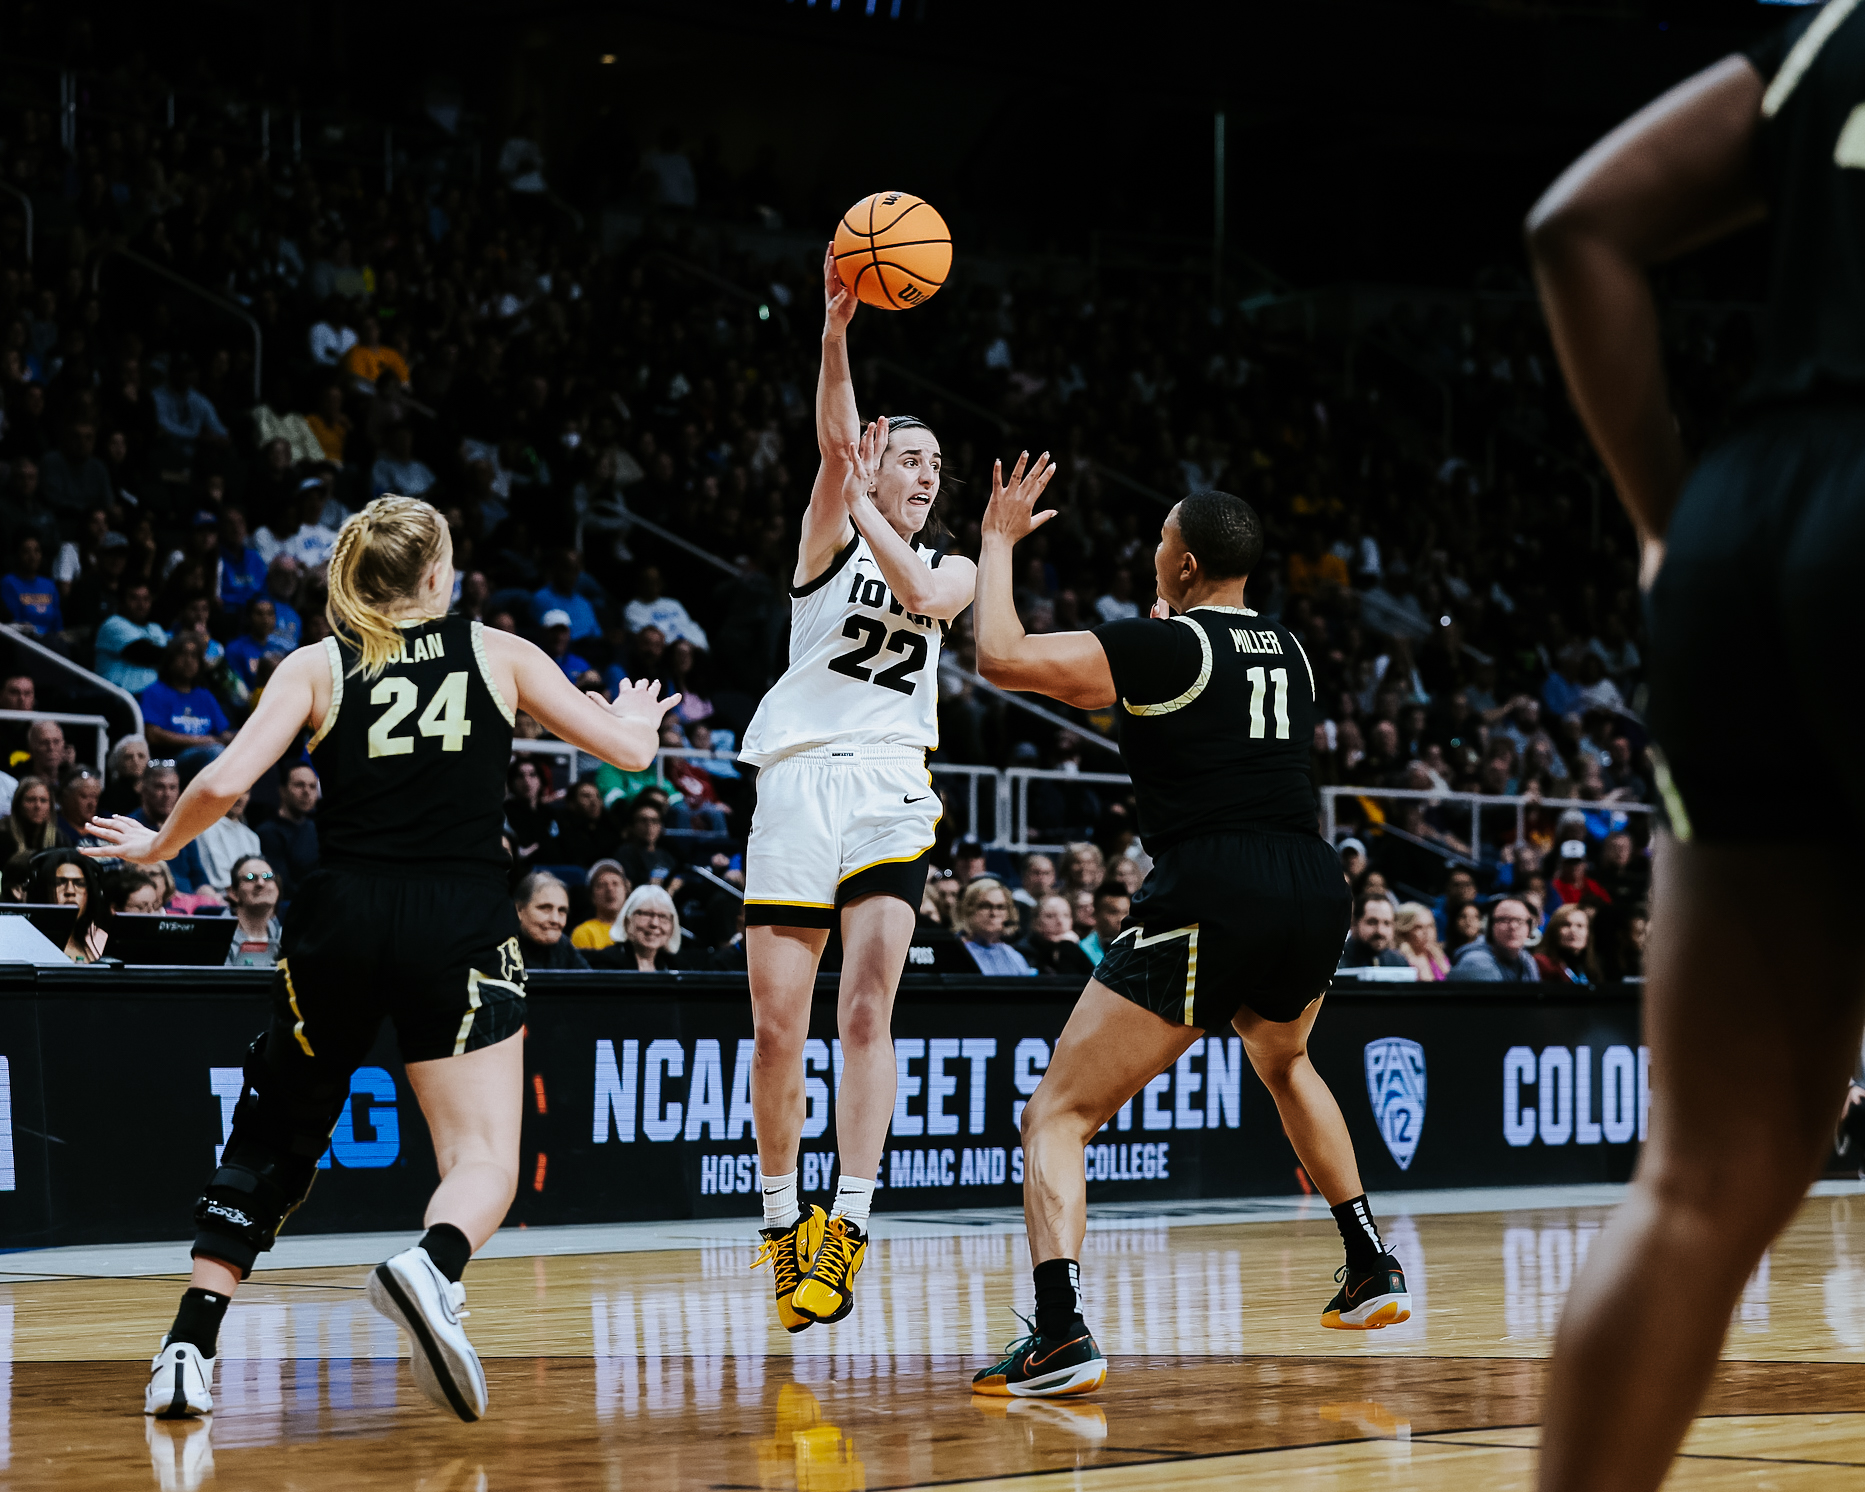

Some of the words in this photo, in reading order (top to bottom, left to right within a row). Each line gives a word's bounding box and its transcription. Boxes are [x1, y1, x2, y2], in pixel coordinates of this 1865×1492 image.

[386, 632, 445, 664] OLAN
[828, 614, 927, 696] 22
[1229, 628, 1283, 655] MILLER
[368, 671, 471, 758] 24
[1246, 667, 1290, 739] 11
[593, 1038, 757, 1143] NCAA
[801, 1038, 997, 1139] SEET
[1011, 1036, 1242, 1136] SEEN
[701, 1154, 761, 1195] HOST
[802, 1151, 835, 1191] BY
[889, 1149, 955, 1188] MAAC
[959, 1147, 1006, 1185] AND
[1084, 1142, 1169, 1181] COLLEGE
